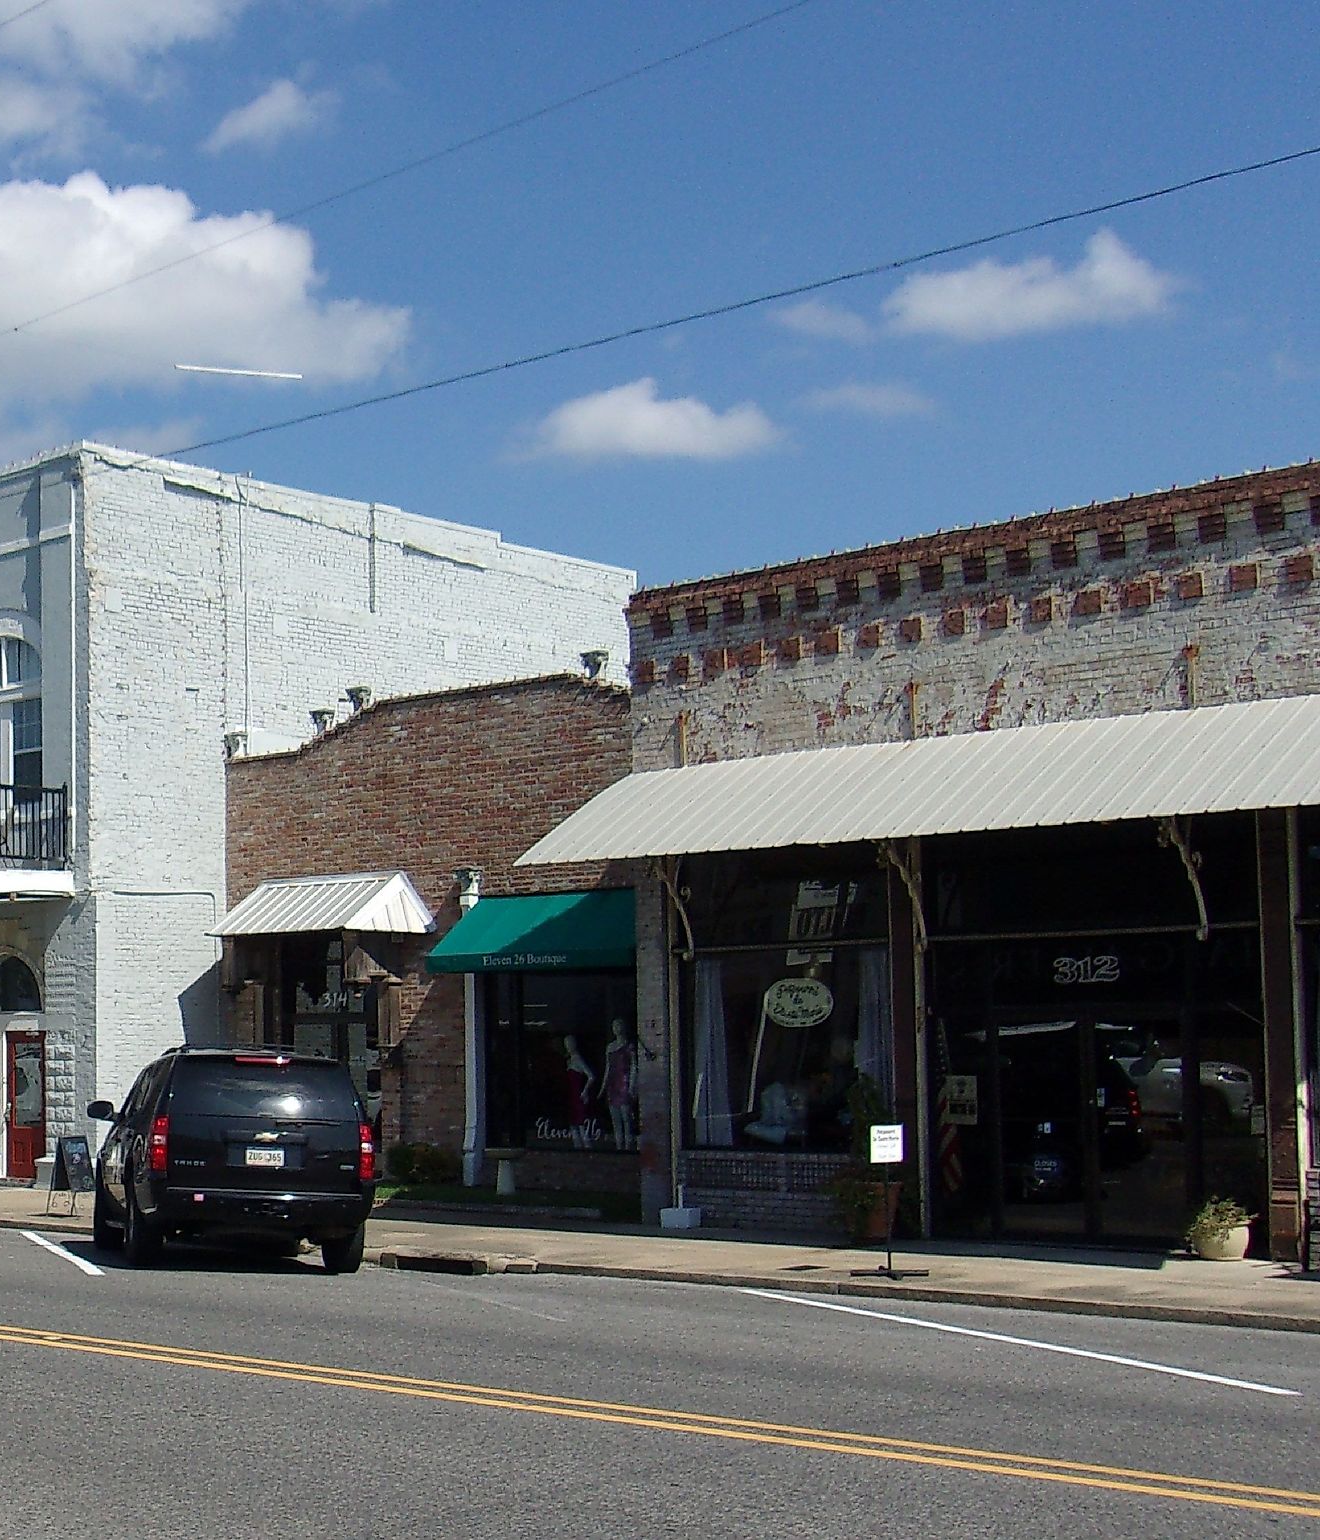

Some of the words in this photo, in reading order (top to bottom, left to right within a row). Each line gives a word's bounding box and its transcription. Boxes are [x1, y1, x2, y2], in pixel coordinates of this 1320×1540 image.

[482, 955, 512, 967] Eleven
[513, 953, 525, 965] 26
[526, 952, 567, 966] Boutique
[1053, 955, 1119, 984] 312
[322, 991, 348, 1008] 314
[173, 1159, 207, 1167] TAHOE
